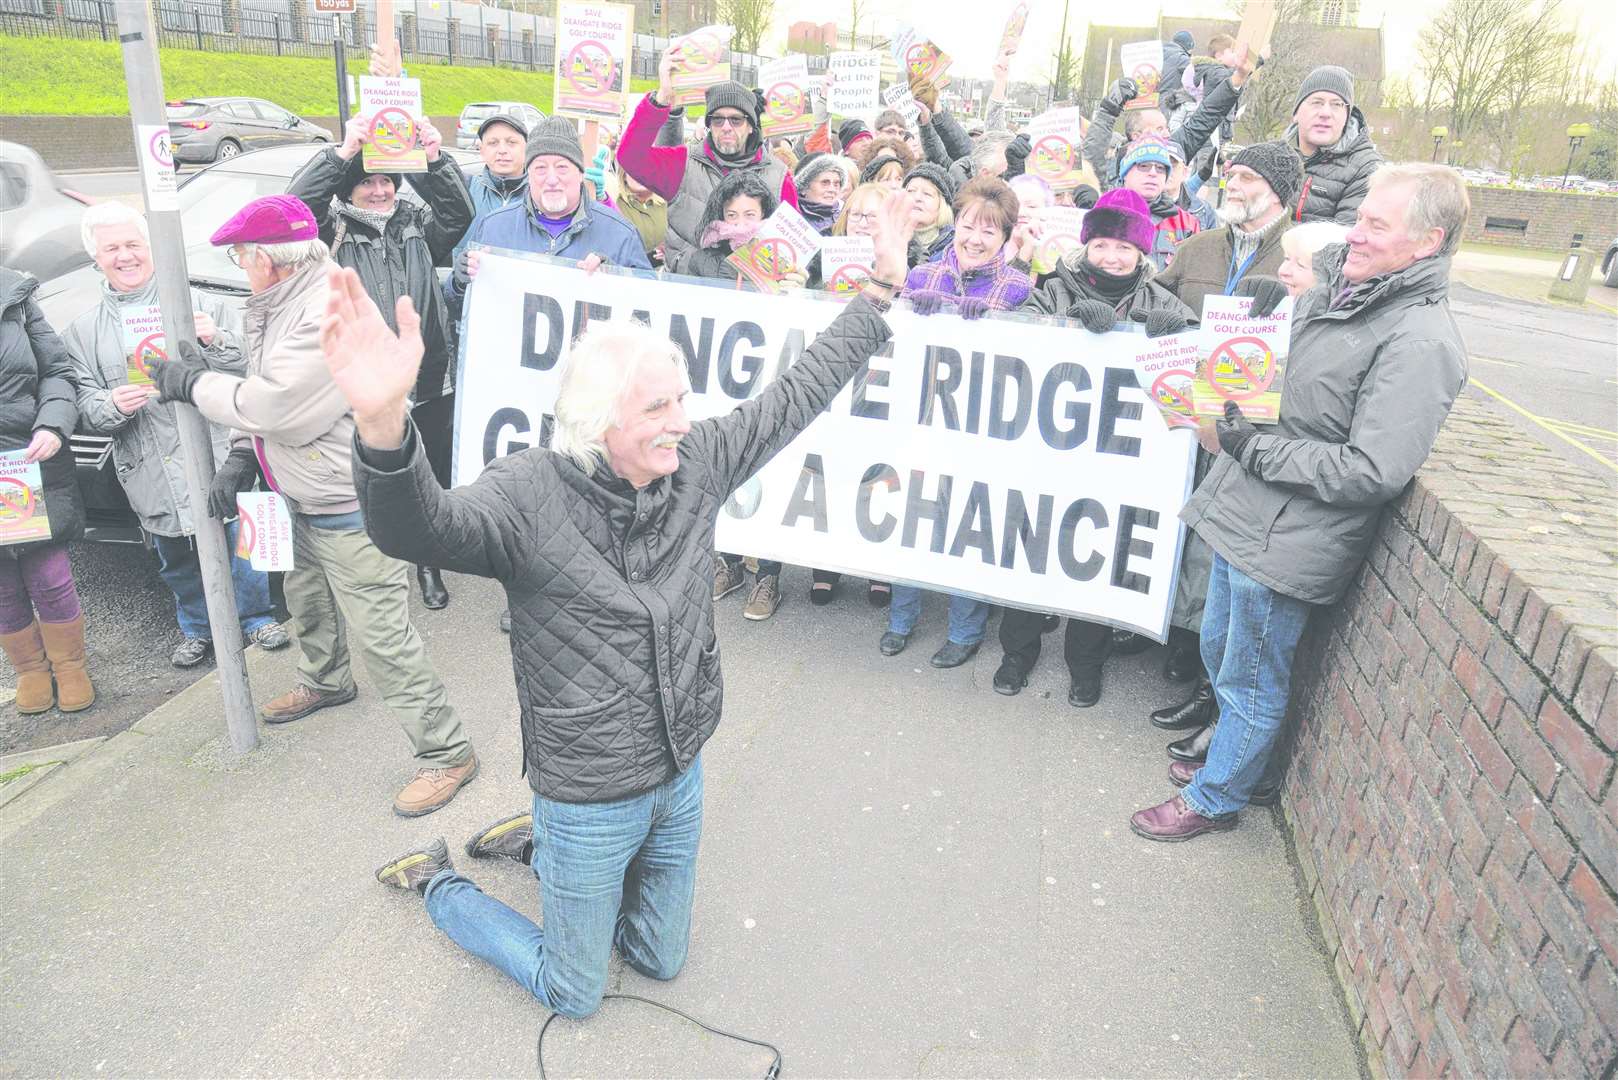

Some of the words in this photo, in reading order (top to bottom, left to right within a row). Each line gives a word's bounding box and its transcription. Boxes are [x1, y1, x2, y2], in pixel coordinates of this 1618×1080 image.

[584, 8, 602, 17] SAVE
[563, 17, 600, 28] DEANGATE
[601, 21, 623, 31] RIDGE
[568, 28, 587, 37] GOLF
[588, 31, 616, 40] COURSE
[832, 58, 878, 68] RIDGE
[834, 72, 852, 82] Let
[856, 73, 874, 81] the
[363, 88, 400, 97] DEANGATE
[833, 87, 873, 97] People
[833, 101, 873, 111] Speak!
[125, 316, 161, 325] DEANGAT
[133, 326, 153, 334] GOLF
[1214, 324, 1241, 333] GOLF
[1241, 325, 1278, 334] COURSE
[1158, 337, 1179, 348] SAVE
[1136, 349, 1179, 362] DEANGATE
[1144, 362, 1165, 372] GOLF
[1167, 357, 1196, 368] COURS
[918, 344, 1144, 458] RIDGE
[0, 468, 28, 476] OURSE
[256, 503, 265, 525] GOLF
[267, 496, 278, 540] DEANGATE
[780, 453, 829, 533] A
[855, 462, 1160, 596] CHANCE
[257, 527, 267, 560] COURSE
[270, 541, 279, 567] RIDGE
